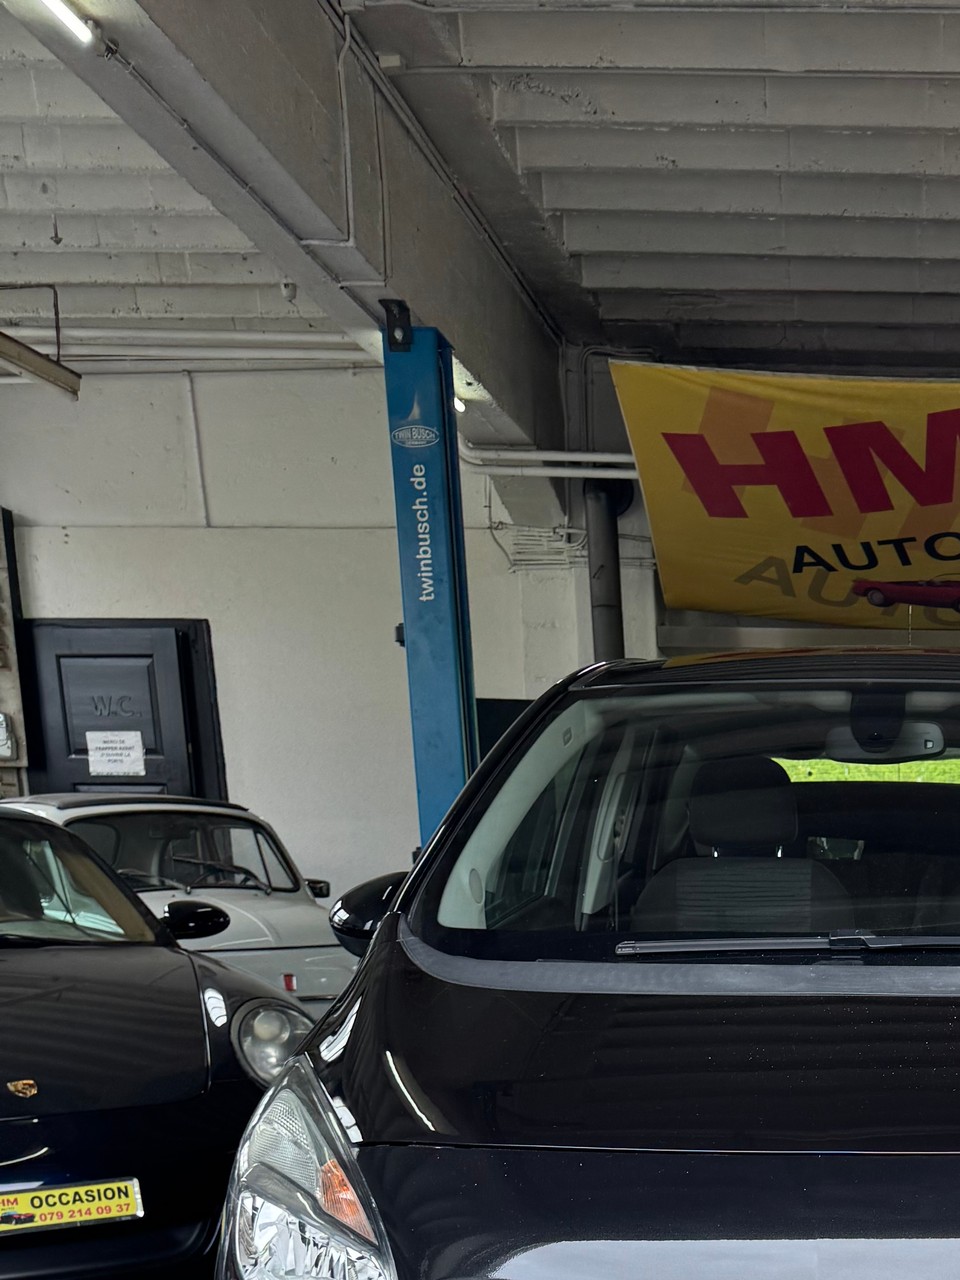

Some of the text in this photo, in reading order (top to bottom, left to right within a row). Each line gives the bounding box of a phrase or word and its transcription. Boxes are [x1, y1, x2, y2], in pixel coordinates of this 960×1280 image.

[394, 427, 436, 439] TWIN BUSCH
[410, 464, 435, 602] twinbusch.de
[30, 1185, 130, 1209] OCCASION
[39, 1203, 131, 1222] 079 214 09 37
